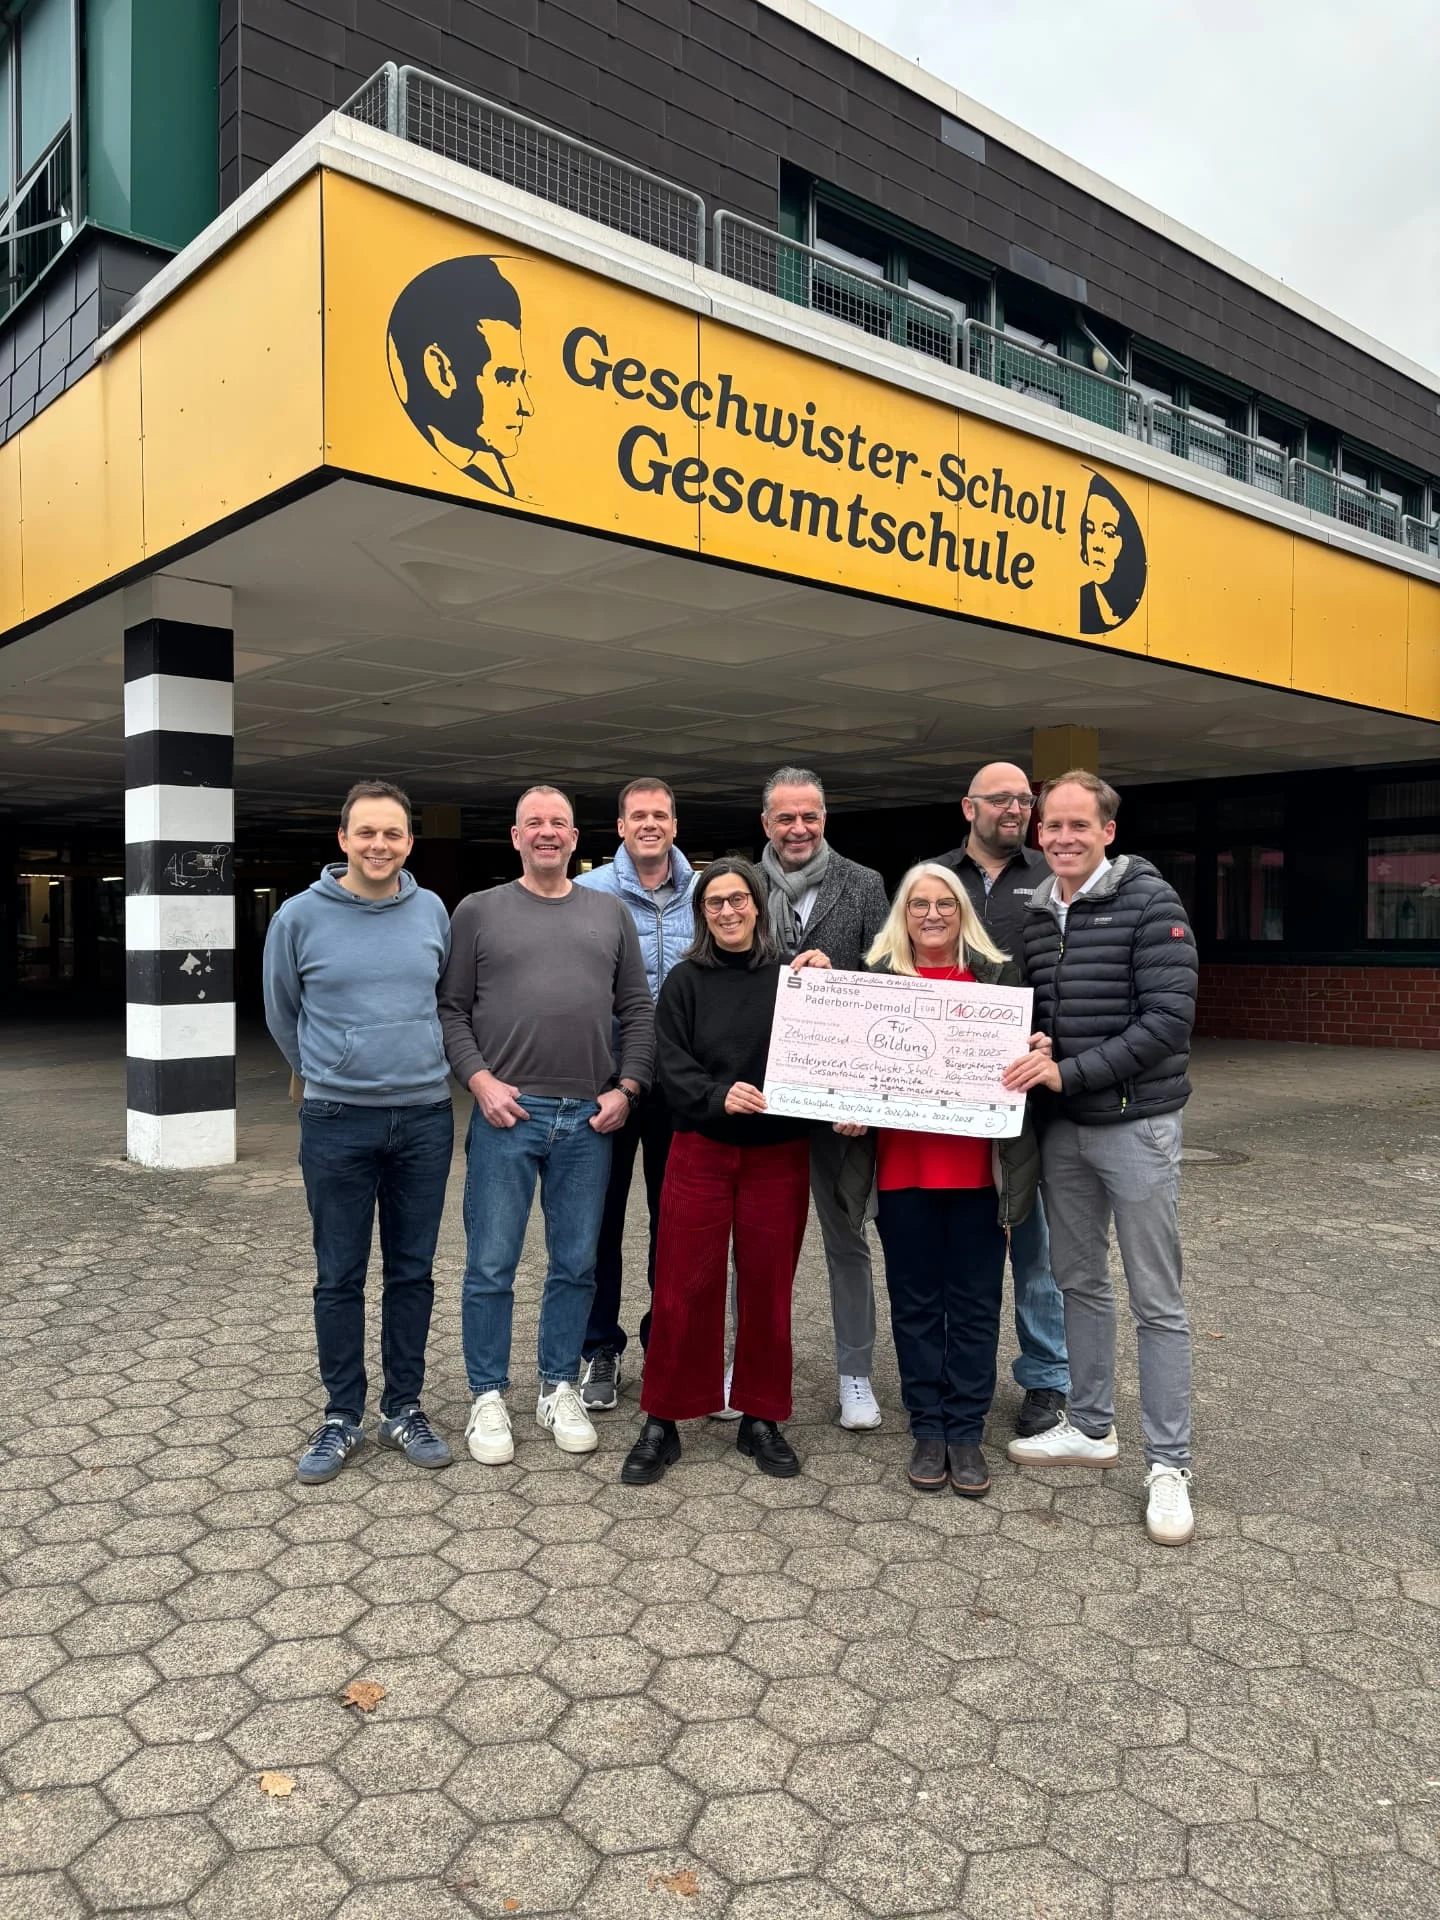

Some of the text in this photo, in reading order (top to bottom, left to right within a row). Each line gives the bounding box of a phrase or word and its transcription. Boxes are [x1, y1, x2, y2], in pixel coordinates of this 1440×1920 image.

[562, 326, 1066, 535] Geschwister-Scholl
[618, 425, 1035, 589] Gesamtschule
[807, 983, 861, 996] Sparkasse
[805, 994, 911, 1014] Paderborn-Detmold
[785, 1024, 849, 1044] Zehntausend
[888, 1020, 912, 1034] Für
[949, 1026, 1000, 1038] Detmold
[873, 1033, 929, 1059] Bildung
